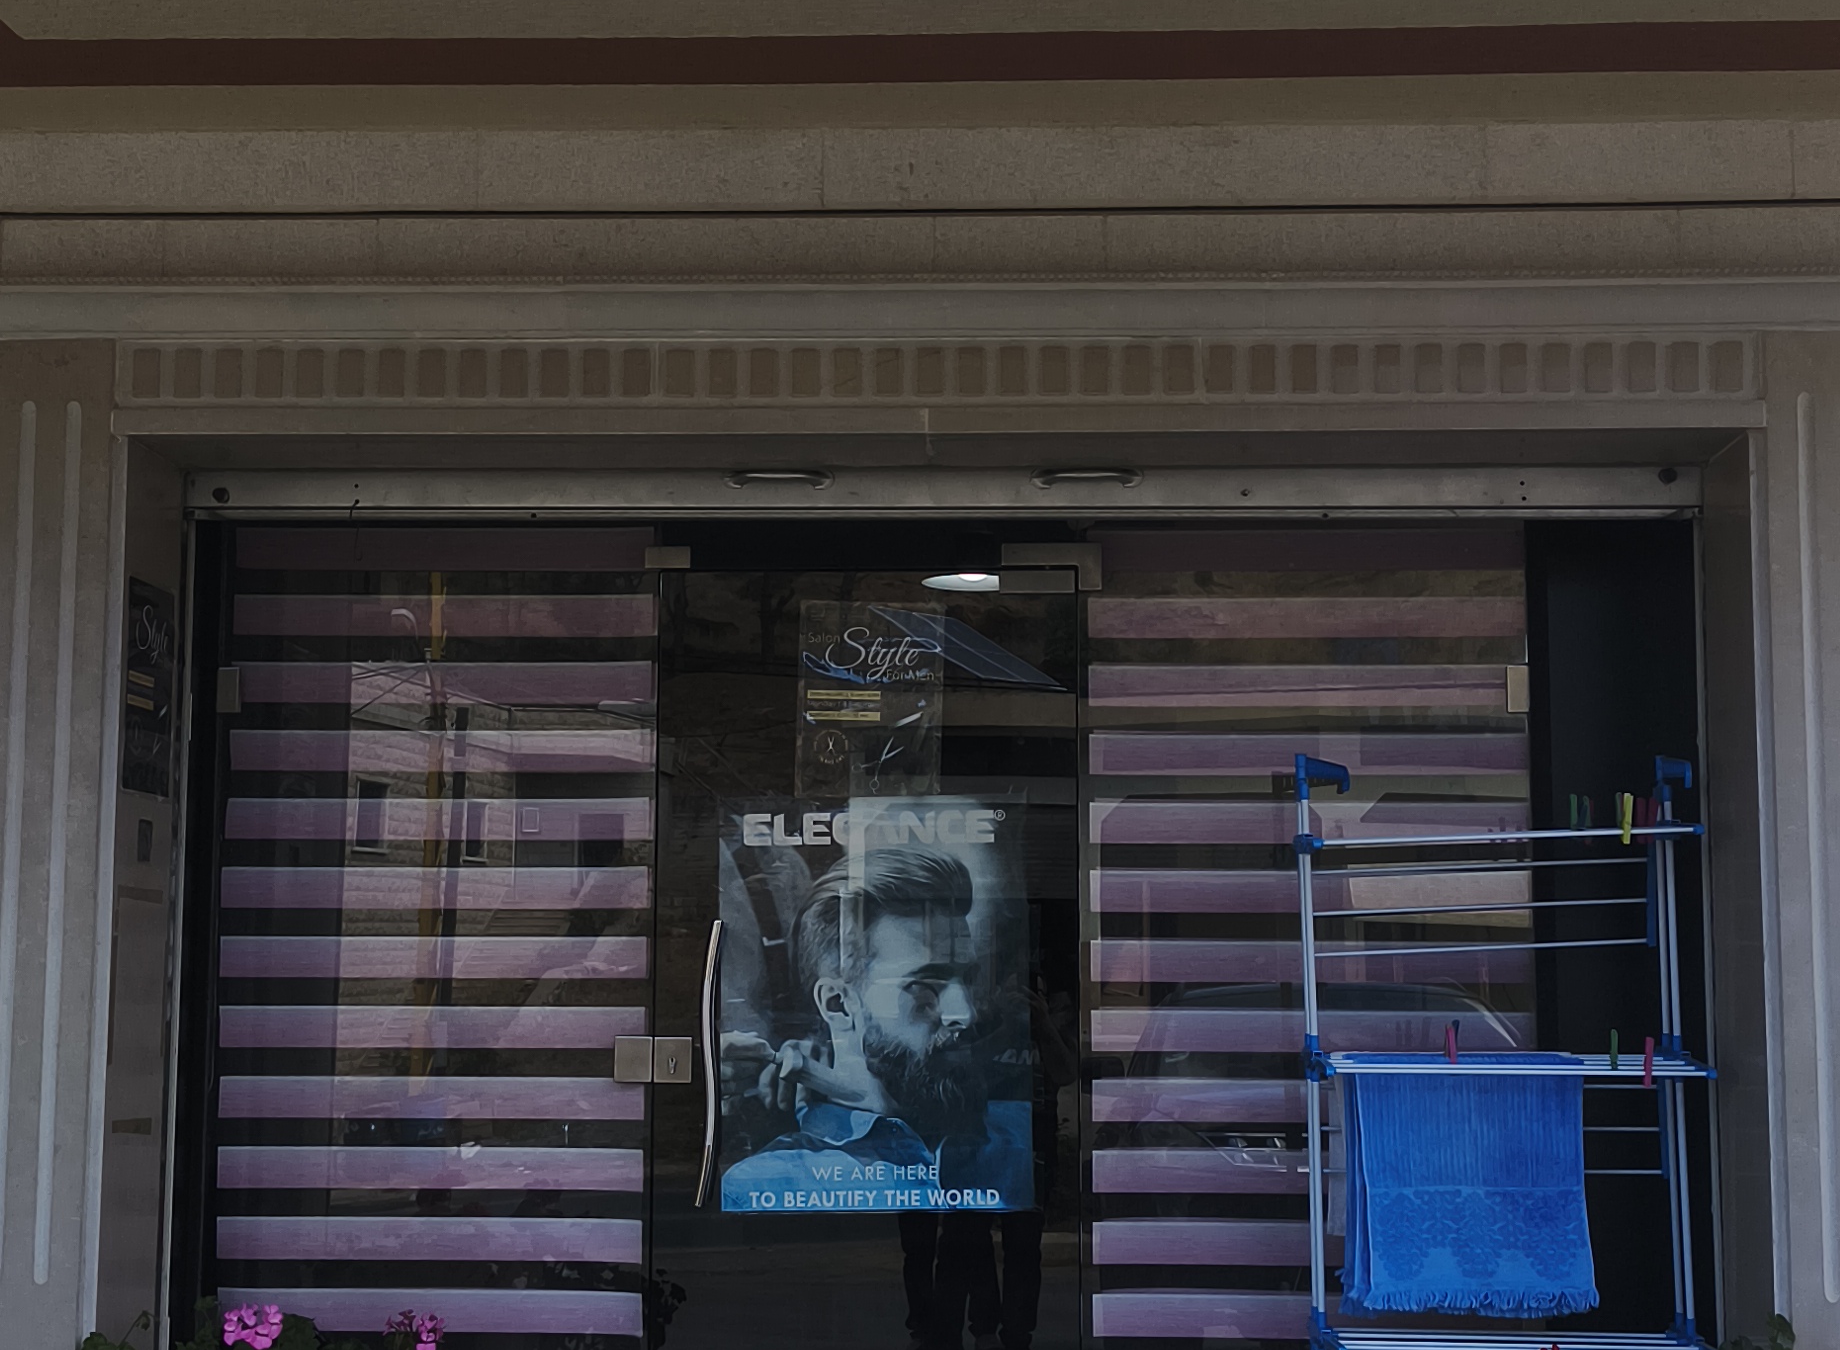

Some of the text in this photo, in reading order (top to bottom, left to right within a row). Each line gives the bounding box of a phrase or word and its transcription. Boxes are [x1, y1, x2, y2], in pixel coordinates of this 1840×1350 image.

[808, 627, 919, 680] Salon Style
[886, 669, 904, 681] For
[812, 1165, 938, 1181] WE ARE HERE
[749, 1189, 1000, 1208] TO BEAUTIFY THE WORLD
